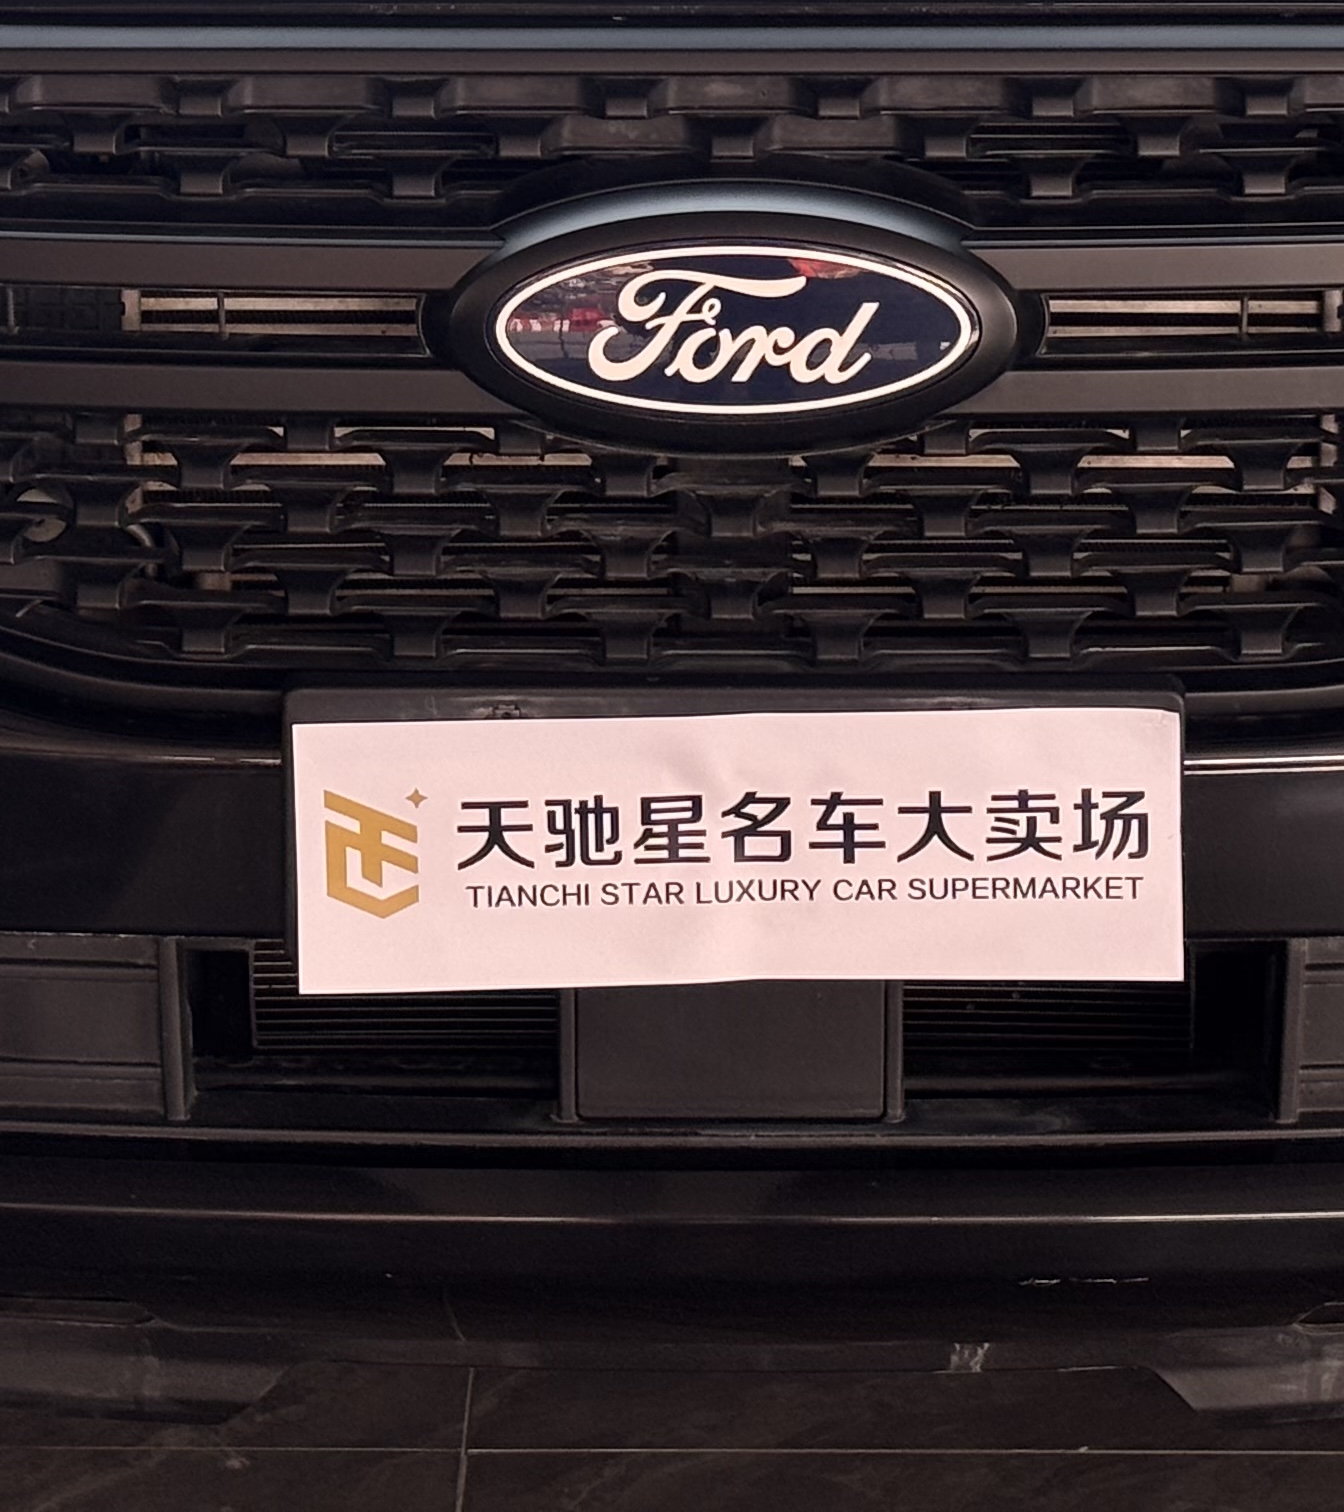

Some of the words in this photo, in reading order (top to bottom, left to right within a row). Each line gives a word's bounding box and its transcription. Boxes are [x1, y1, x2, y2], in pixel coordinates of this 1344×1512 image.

[587, 268, 879, 385] Ford
[456, 789, 1150, 871] 天驰星名车大卖场
[465, 883, 590, 908] TIANCHI
[600, 881, 685, 906] STAR
[695, 878, 822, 905] LUXURY
[832, 878, 898, 901] CAR
[907, 876, 1145, 901] SUPERMARKET
